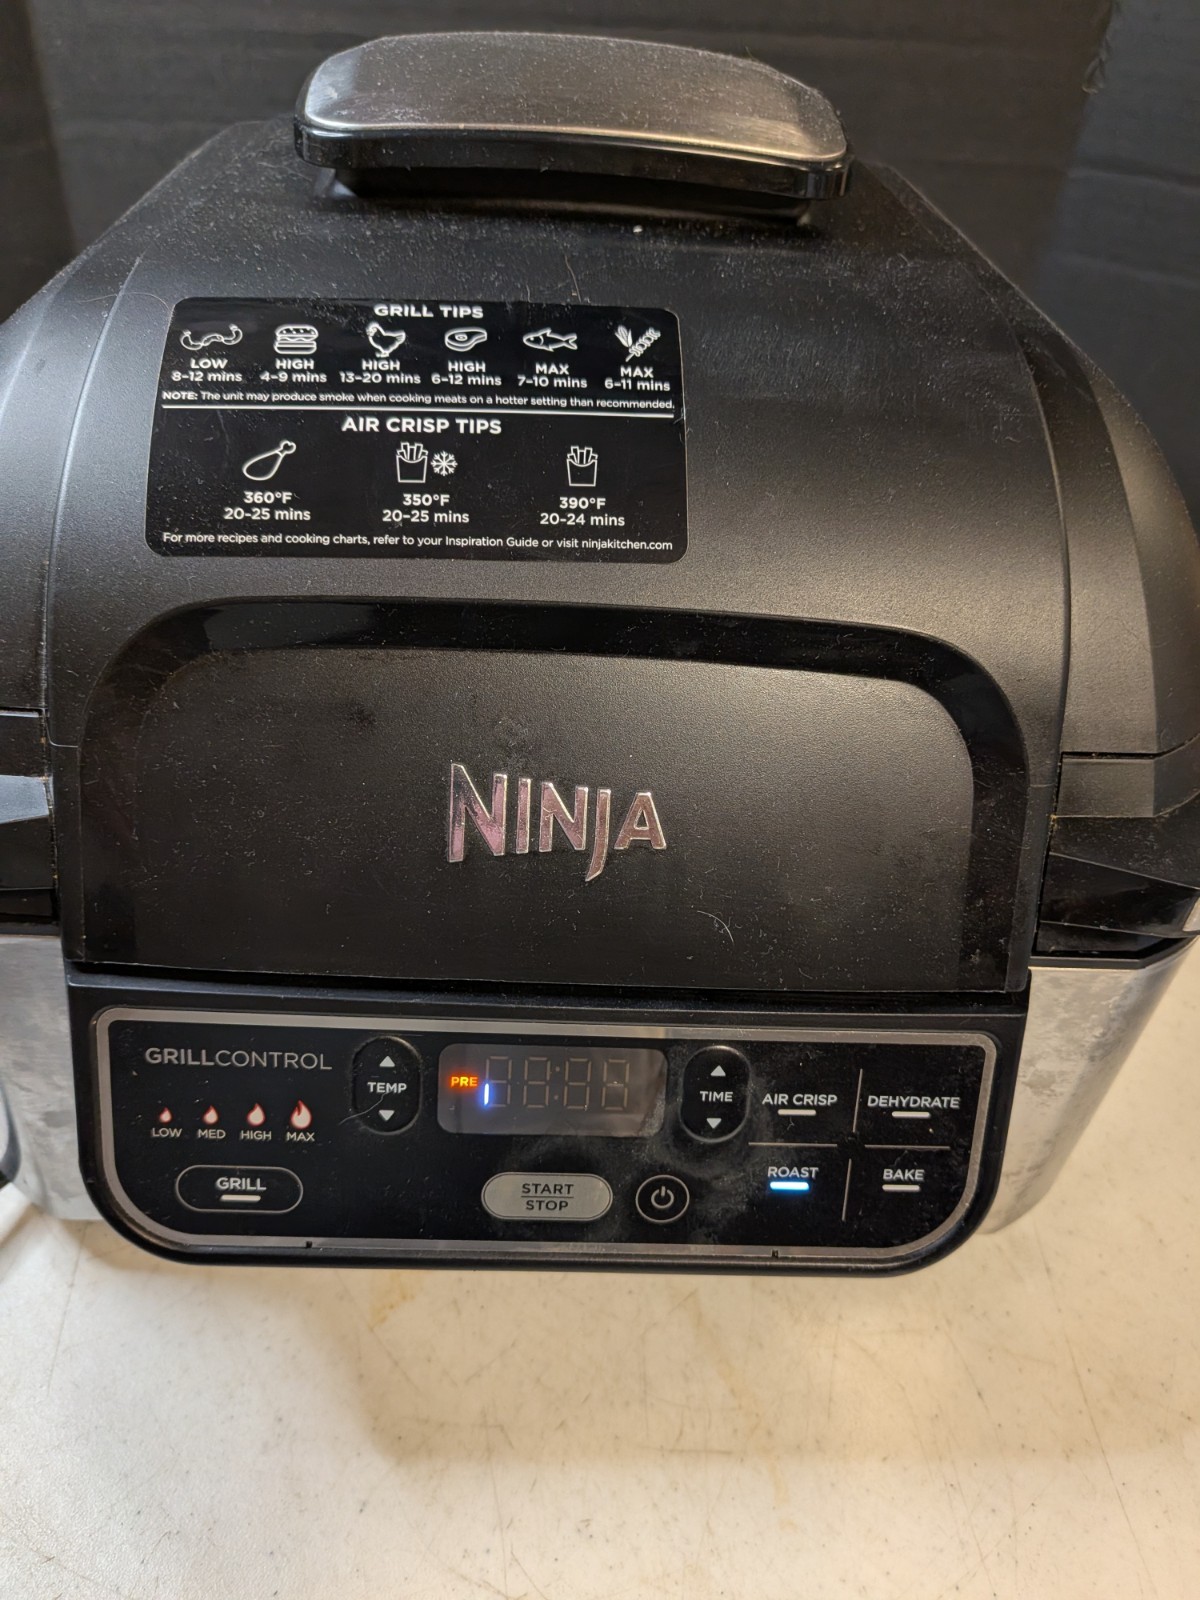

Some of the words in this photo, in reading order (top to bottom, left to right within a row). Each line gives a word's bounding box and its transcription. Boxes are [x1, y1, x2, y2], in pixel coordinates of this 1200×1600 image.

[374, 304, 433, 318] GRILL
[439, 305, 484, 319] TIPS
[190, 358, 228, 369] LOW
[276, 358, 314, 369] HIGH
[362, 359, 400, 371] HIGH
[448, 361, 486, 372] HIGH
[536, 363, 569, 375] MAX
[171, 371, 204, 382] 8-12
[207, 371, 242, 382] mins
[260, 371, 288, 382] 4-9
[292, 372, 327, 382] mins
[621, 365, 654, 378] MAX
[340, 372, 382, 383] 13-20
[386, 372, 421, 384] mins
[431, 374, 463, 385] 6-12
[467, 375, 502, 386] mins
[517, 376, 549, 386] 7-10
[553, 376, 587, 388] mins
[604, 378, 632, 390] 6-11
[637, 380, 670, 391] mins
[162, 392, 198, 400] NOTE:
[201, 392, 221, 401] The
[223, 392, 244, 401] unit
[246, 393, 270, 403] may
[272, 392, 317, 403] produce
[319, 392, 354, 402] smoke
[357, 393, 387, 402] when
[389, 392, 431, 404] cooking
[434, 395, 467, 404] meats
[470, 396, 483, 404] on
[495, 395, 528, 405] hotter
[530, 396, 568, 408] setting
[570, 397, 593, 407] than
[596, 398, 674, 409] recommended.
[341, 417, 379, 431] AIR
[386, 418, 449, 433] CRISP
[456, 419, 502, 434] TIPS
[244, 491, 292, 504] 360°F
[403, 494, 450, 506] 350°F
[559, 497, 606, 509] 390°F
[224, 508, 270, 519] 20-25
[274, 508, 311, 520] mins
[382, 509, 429, 522] 20-25
[434, 512, 469, 523] mins
[540, 514, 585, 525] 20-24
[590, 515, 625, 526] mins
[163, 533, 182, 542] For
[185, 534, 215, 543] more
[218, 534, 258, 544] recipes
[261, 533, 283, 543] and
[285, 534, 329, 544] cooking
[333, 534, 370, 545] charts,
[373, 535, 400, 545] refer
[402, 536, 414, 545] to
[417, 537, 442, 547] your
[446, 536, 503, 548] Inspiration
[506, 537, 539, 548] Guide
[542, 539, 554, 548] or
[556, 537, 579, 548] visit
[582, 538, 673, 551] ninjakitchen.com
[447, 763, 667, 882] NINJA
[145, 1047, 333, 1070] GRILLCONTROL
[367, 1082, 407, 1094] TEMP
[451, 1077, 478, 1087] PRE
[700, 1090, 733, 1102] TIME
[762, 1093, 789, 1105] AIR
[792, 1093, 838, 1106] CRISP
[867, 1095, 961, 1109] DEHYDRATE
[152, 1127, 182, 1138] LOW
[197, 1129, 226, 1140] MED
[240, 1130, 272, 1141] HIGH
[286, 1131, 315, 1142] MAX
[767, 1167, 819, 1178] ROAST
[883, 1169, 924, 1181] BAKE
[216, 1177, 267, 1191] GRILL
[522, 1183, 574, 1195] START
[525, 1200, 568, 1211] STOP
